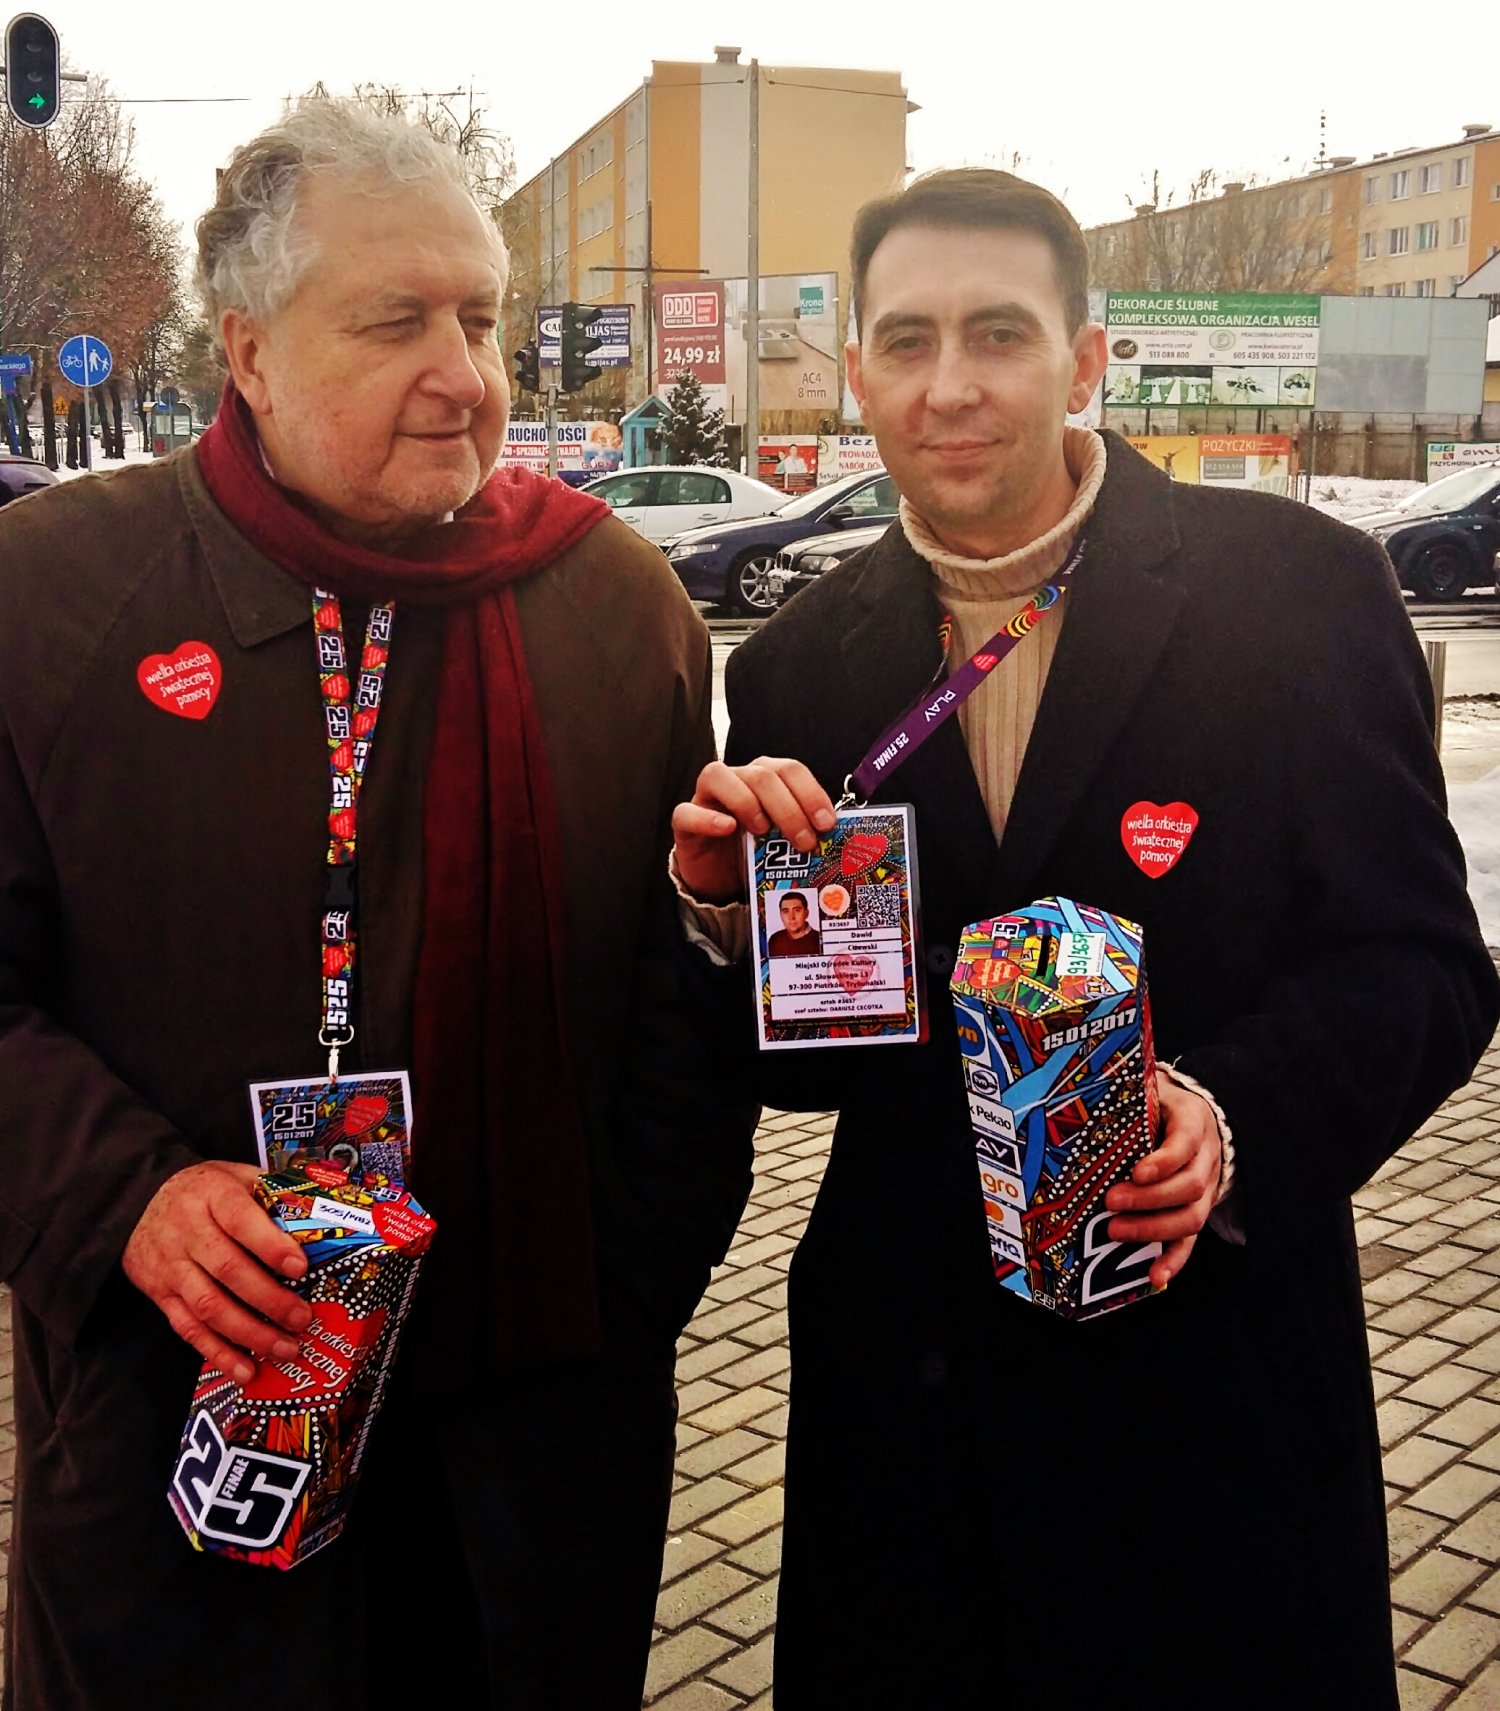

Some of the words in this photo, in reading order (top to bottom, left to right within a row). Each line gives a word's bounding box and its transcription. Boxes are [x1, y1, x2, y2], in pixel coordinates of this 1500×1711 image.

[665, 298, 692, 316] DDD
[799, 298, 824, 308] Krono
[1109, 299, 1174, 310] DEKORACJE
[1176, 297, 1219, 311] ŚLUBNE
[1108, 313, 1198, 325] KOMPLEKSOWA
[1200, 315, 1280, 326] ORGANIZACJA
[1283, 316, 1320, 326] WESEL
[664, 347, 704, 366] 24,99
[706, 345, 720, 364] zł
[1233, 352, 1246, 360] 605
[802, 373, 822, 384] AC4
[797, 388, 804, 398] 8
[806, 388, 827, 398] mm
[508, 426, 586, 441] RUCHOOŚCI
[839, 437, 873, 446] Bez
[369, 607, 392, 641] 25
[318, 635, 344, 669] 25
[145, 663, 176, 685] wielka
[174, 652, 212, 673] orkiestra
[176, 687, 211, 710] pomocy
[358, 674, 382, 708] 25
[326, 706, 350, 739] 25
[332, 776, 352, 808] 25
[1127, 813, 1154, 830] wielka
[1155, 815, 1192, 834] orkiestra
[1132, 831, 1185, 854] świątecznej
[1139, 850, 1175, 867] pomocy
[851, 931, 873, 939] Dawid
[795, 961, 820, 969] Miejski
[851, 958, 877, 967] Kultury
[788, 983, 812, 991] 97-300
[845, 979, 886, 989] Trybunalski
[829, 1005, 855, 1013] DARIUSZ
[273, 1102, 317, 1131] 25
[976, 1105, 1012, 1131] Pekao
[383, 1206, 412, 1222] wielka
